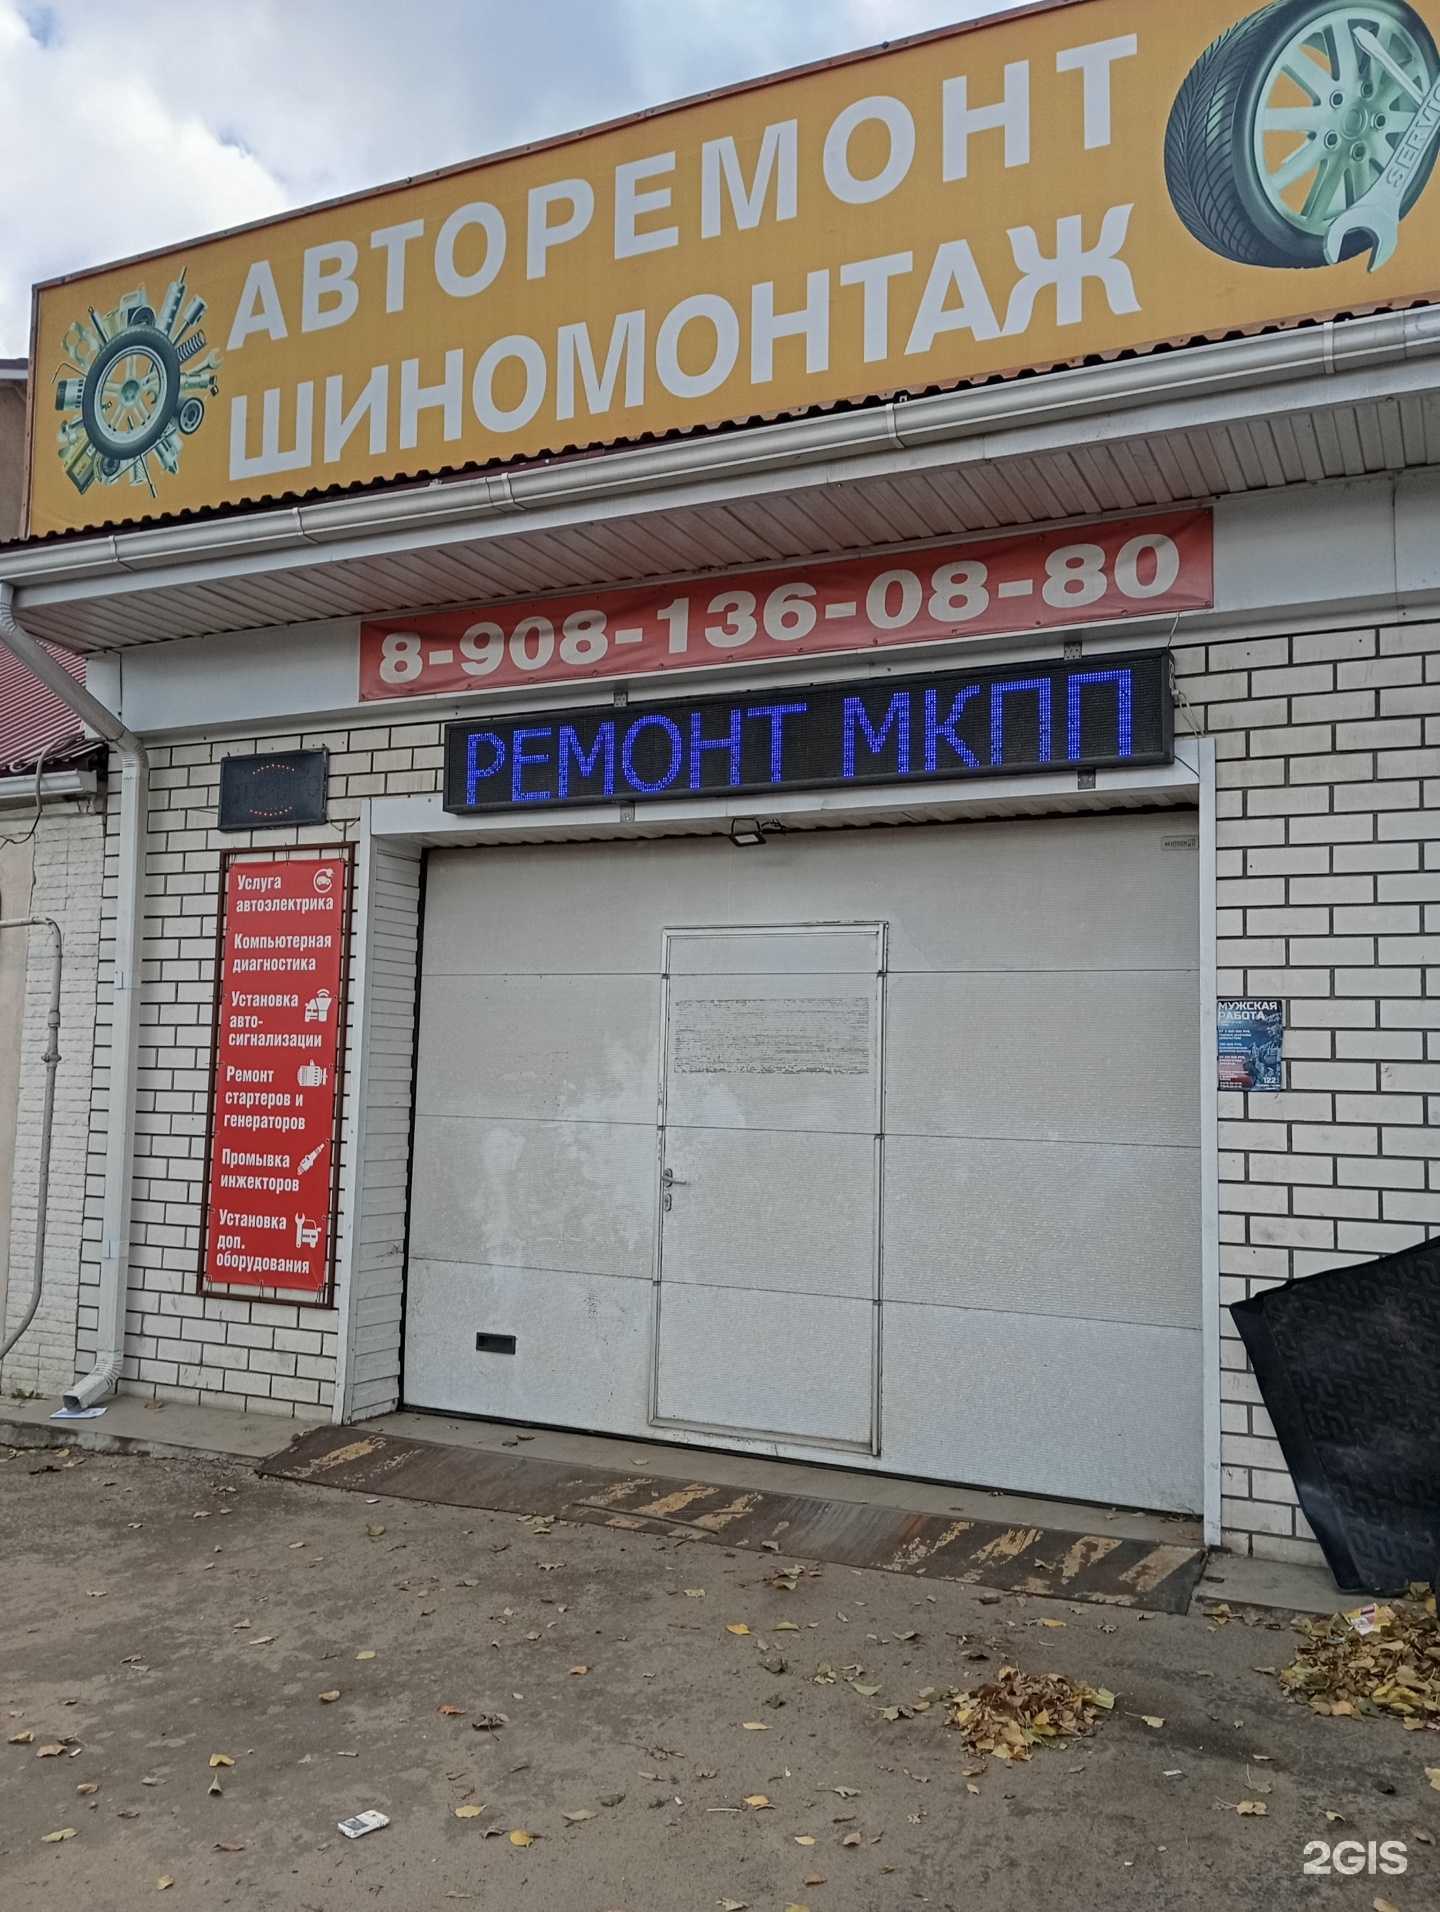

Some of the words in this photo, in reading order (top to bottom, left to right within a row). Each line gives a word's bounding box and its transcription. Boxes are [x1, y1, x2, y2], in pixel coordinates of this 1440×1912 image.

[226, 33, 1138, 351] АВТОРЕМОНТ
[229, 202, 1143, 481] ШИНОМОНТАЖ
[379, 533, 1180, 684] 8-908-136-08-80
[465, 702, 808, 807] РЕМОНТ
[842, 669, 1132, 778] МКПП
[237, 874, 282, 893] Услуга
[236, 896, 334, 914] автоэлектрика
[234, 933, 332, 951] Компьютерная
[232, 957, 316, 973] диагностика
[231, 990, 299, 1008] Установка
[1218, 1001, 1278, 1011] МУЖСКАЯ
[230, 1015, 263, 1028] авто-
[1218, 1011, 1265, 1020] РАБОТА
[228, 1033, 322, 1048] сигнализации
[226, 1065, 274, 1083] Ремонт
[225, 1091, 291, 1109] стартеров
[295, 1093, 303, 1107] и
[224, 1113, 305, 1133] генераторов
[222, 1148, 290, 1169] Промывка
[220, 1174, 299, 1194] инжекторов
[219, 1208, 287, 1230] Установка
[217, 1234, 245, 1250] доп.
[216, 1252, 310, 1275] оборудования
